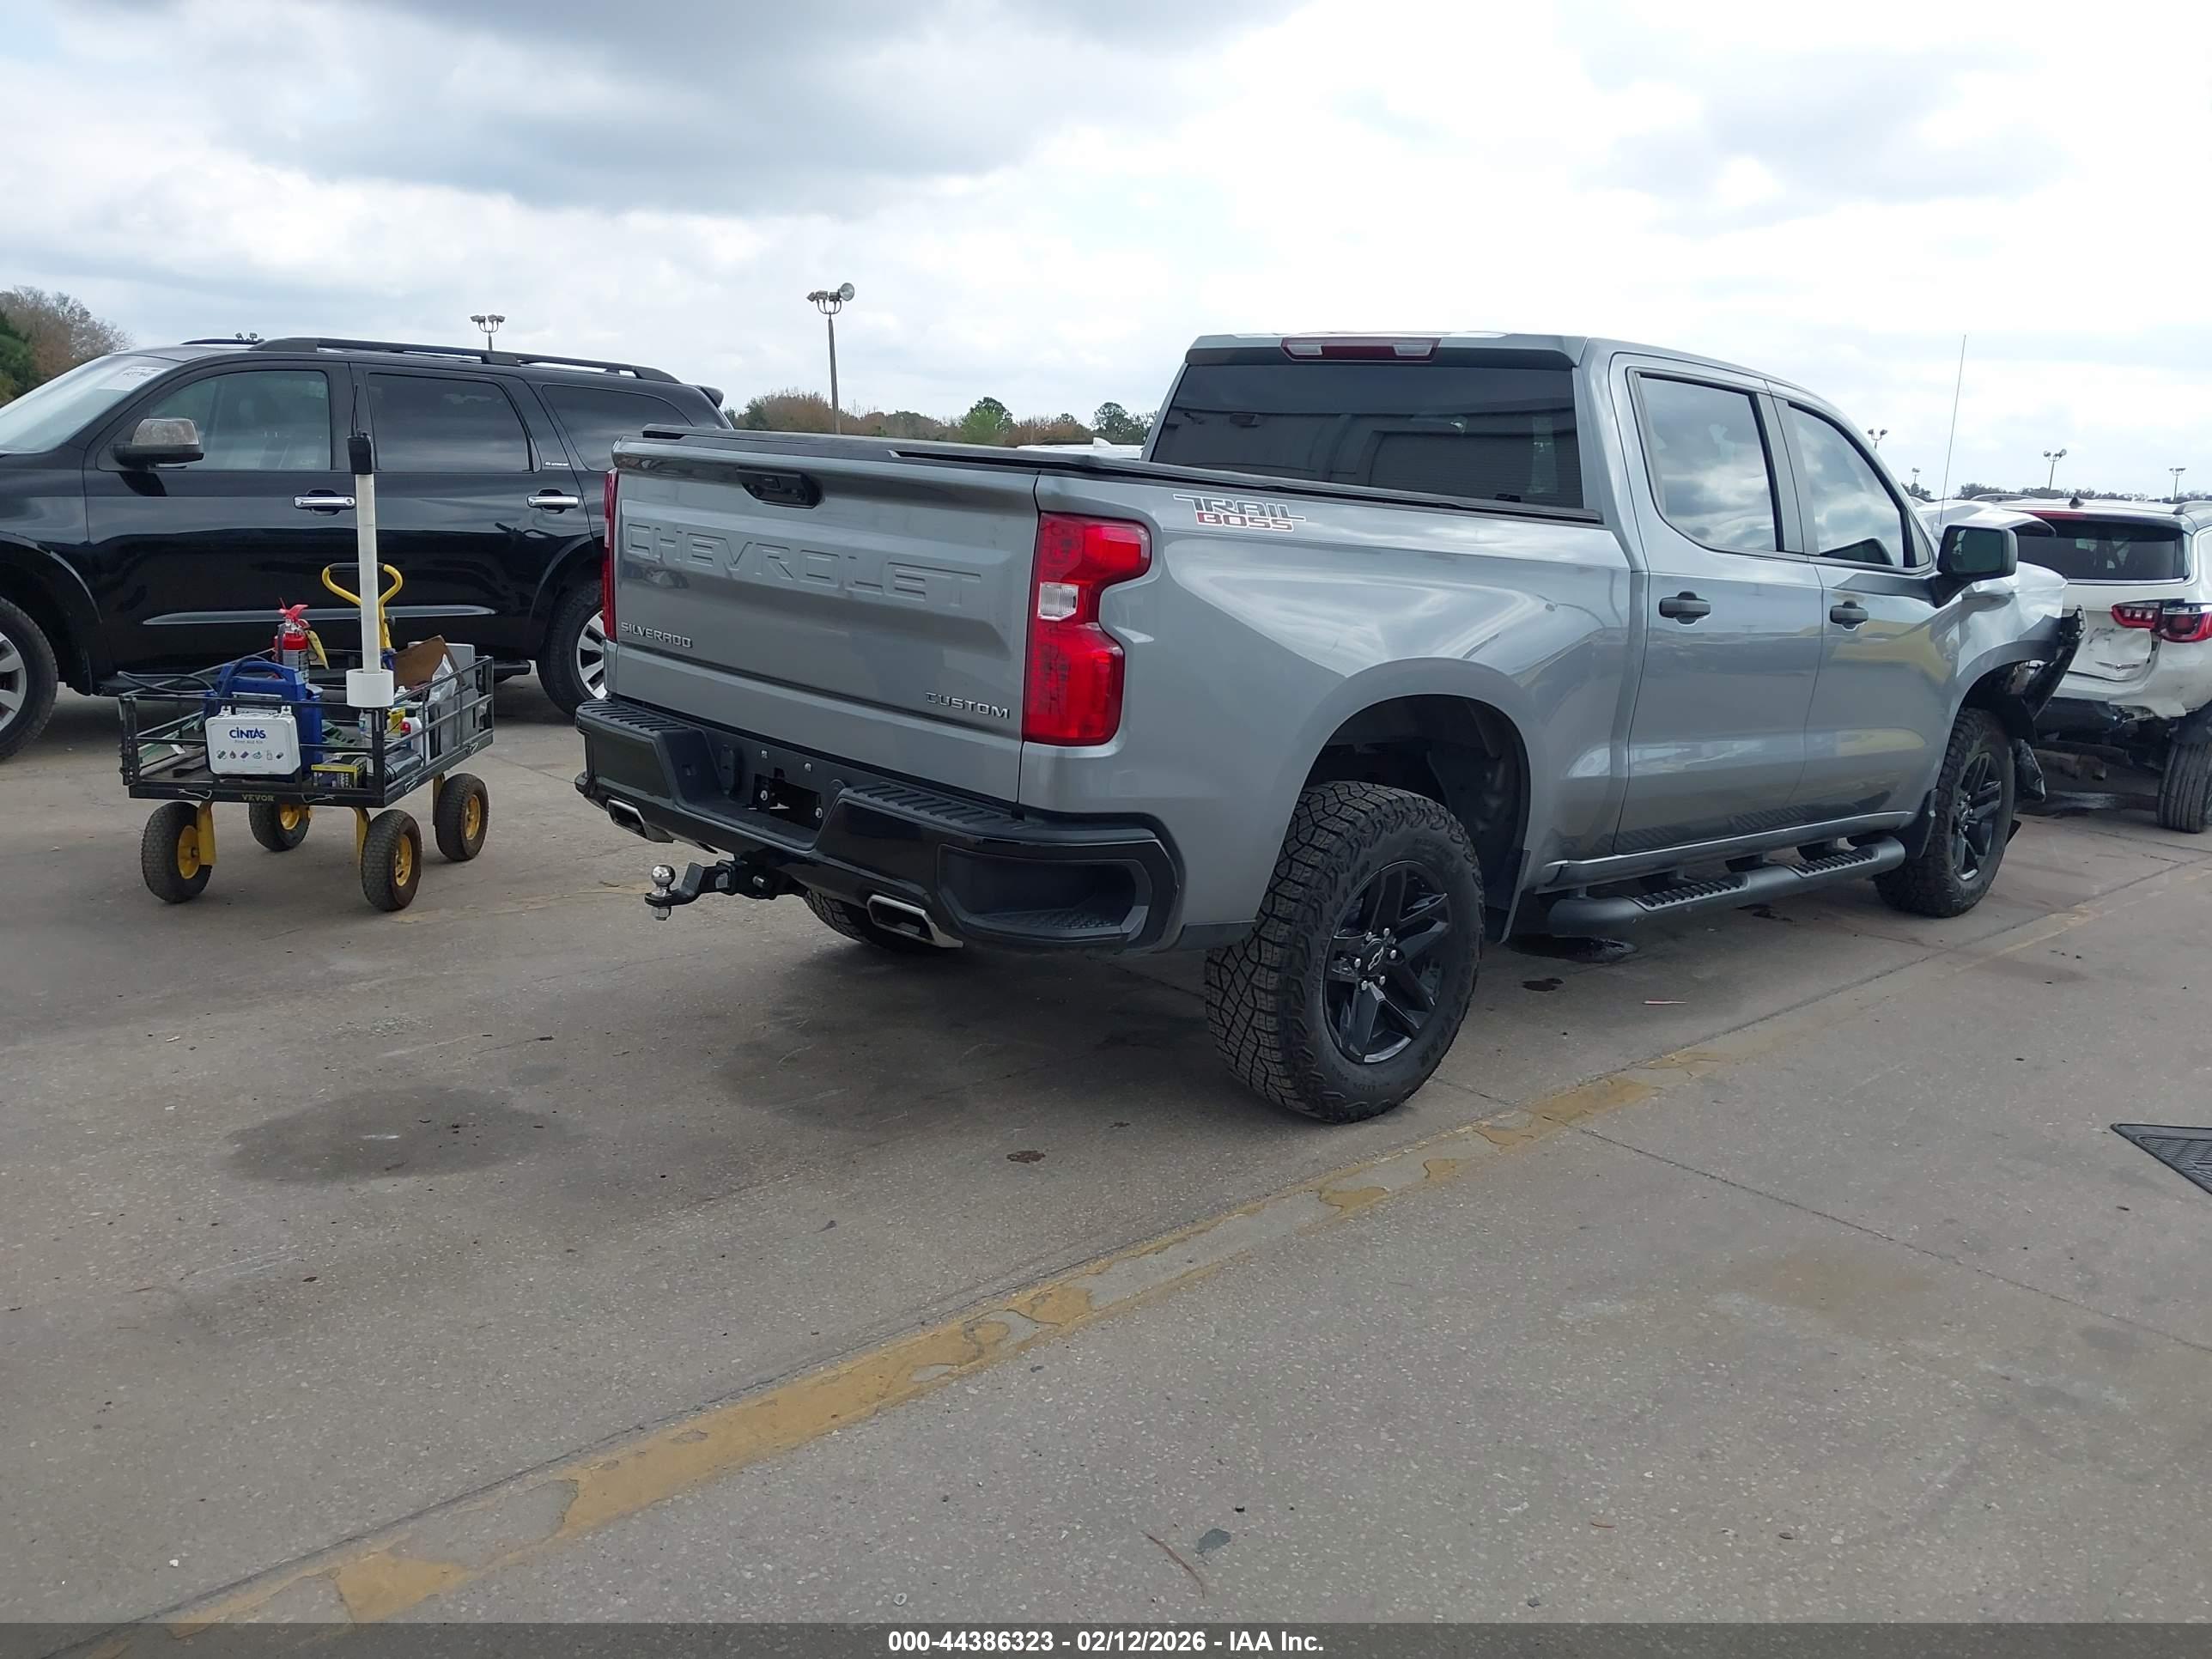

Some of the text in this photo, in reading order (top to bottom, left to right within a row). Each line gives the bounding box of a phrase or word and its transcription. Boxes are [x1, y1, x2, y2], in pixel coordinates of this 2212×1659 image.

[1173, 493, 1306, 521] TRAIL
[1195, 510, 1295, 532] BOSS
[627, 522, 982, 607] CHEVROLET
[620, 622, 692, 648] SILVERADO
[925, 691, 1011, 720] CUSTOM
[241, 793, 275, 802] VEVOR
